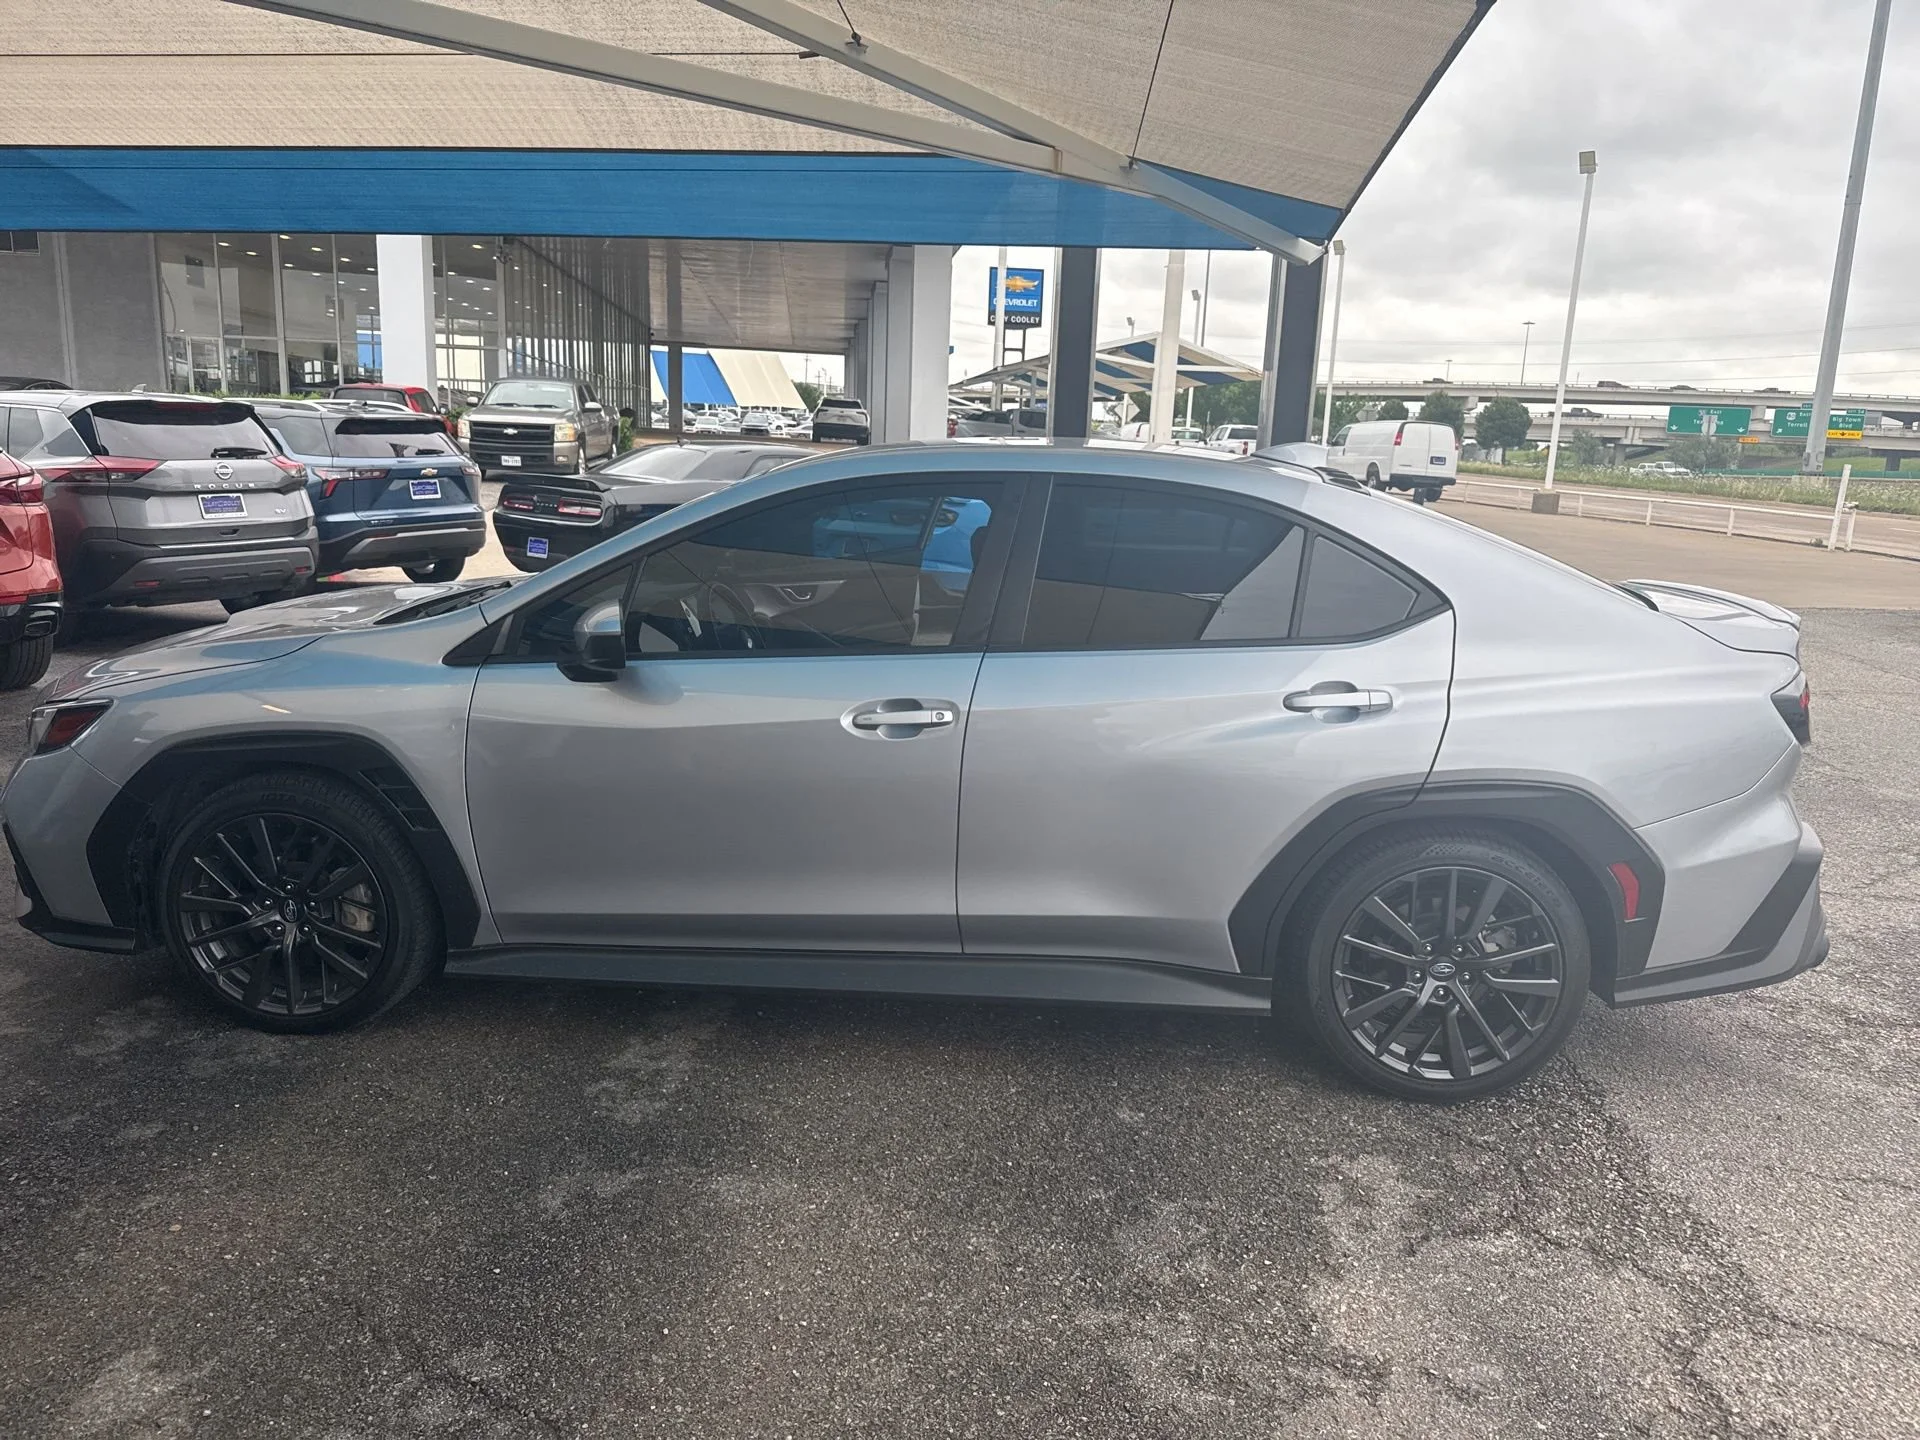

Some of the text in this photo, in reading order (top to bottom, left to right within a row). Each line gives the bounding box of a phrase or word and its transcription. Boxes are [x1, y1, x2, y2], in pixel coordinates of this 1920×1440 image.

[993, 298, 1037, 306] CEVROLET
[1010, 315, 1039, 323] COOLEY
[194, 482, 255, 490] ROGUE
